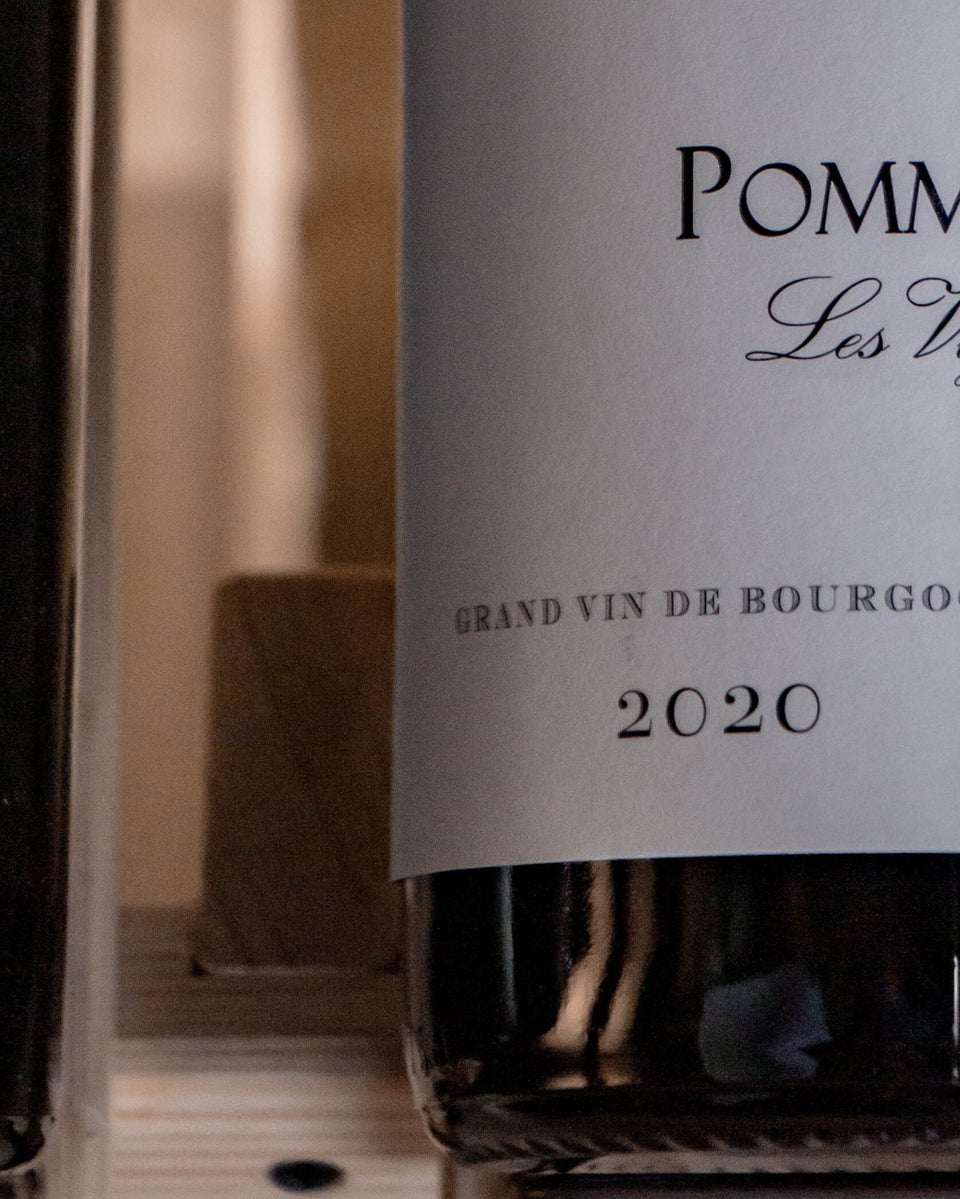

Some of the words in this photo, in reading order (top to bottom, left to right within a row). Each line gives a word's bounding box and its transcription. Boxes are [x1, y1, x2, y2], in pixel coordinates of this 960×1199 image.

[744, 275, 890, 361] Les
[454, 597, 563, 635] GRAND
[576, 590, 646, 622] VIN
[664, 587, 722, 618] DE
[617, 682, 822, 738] 2020
